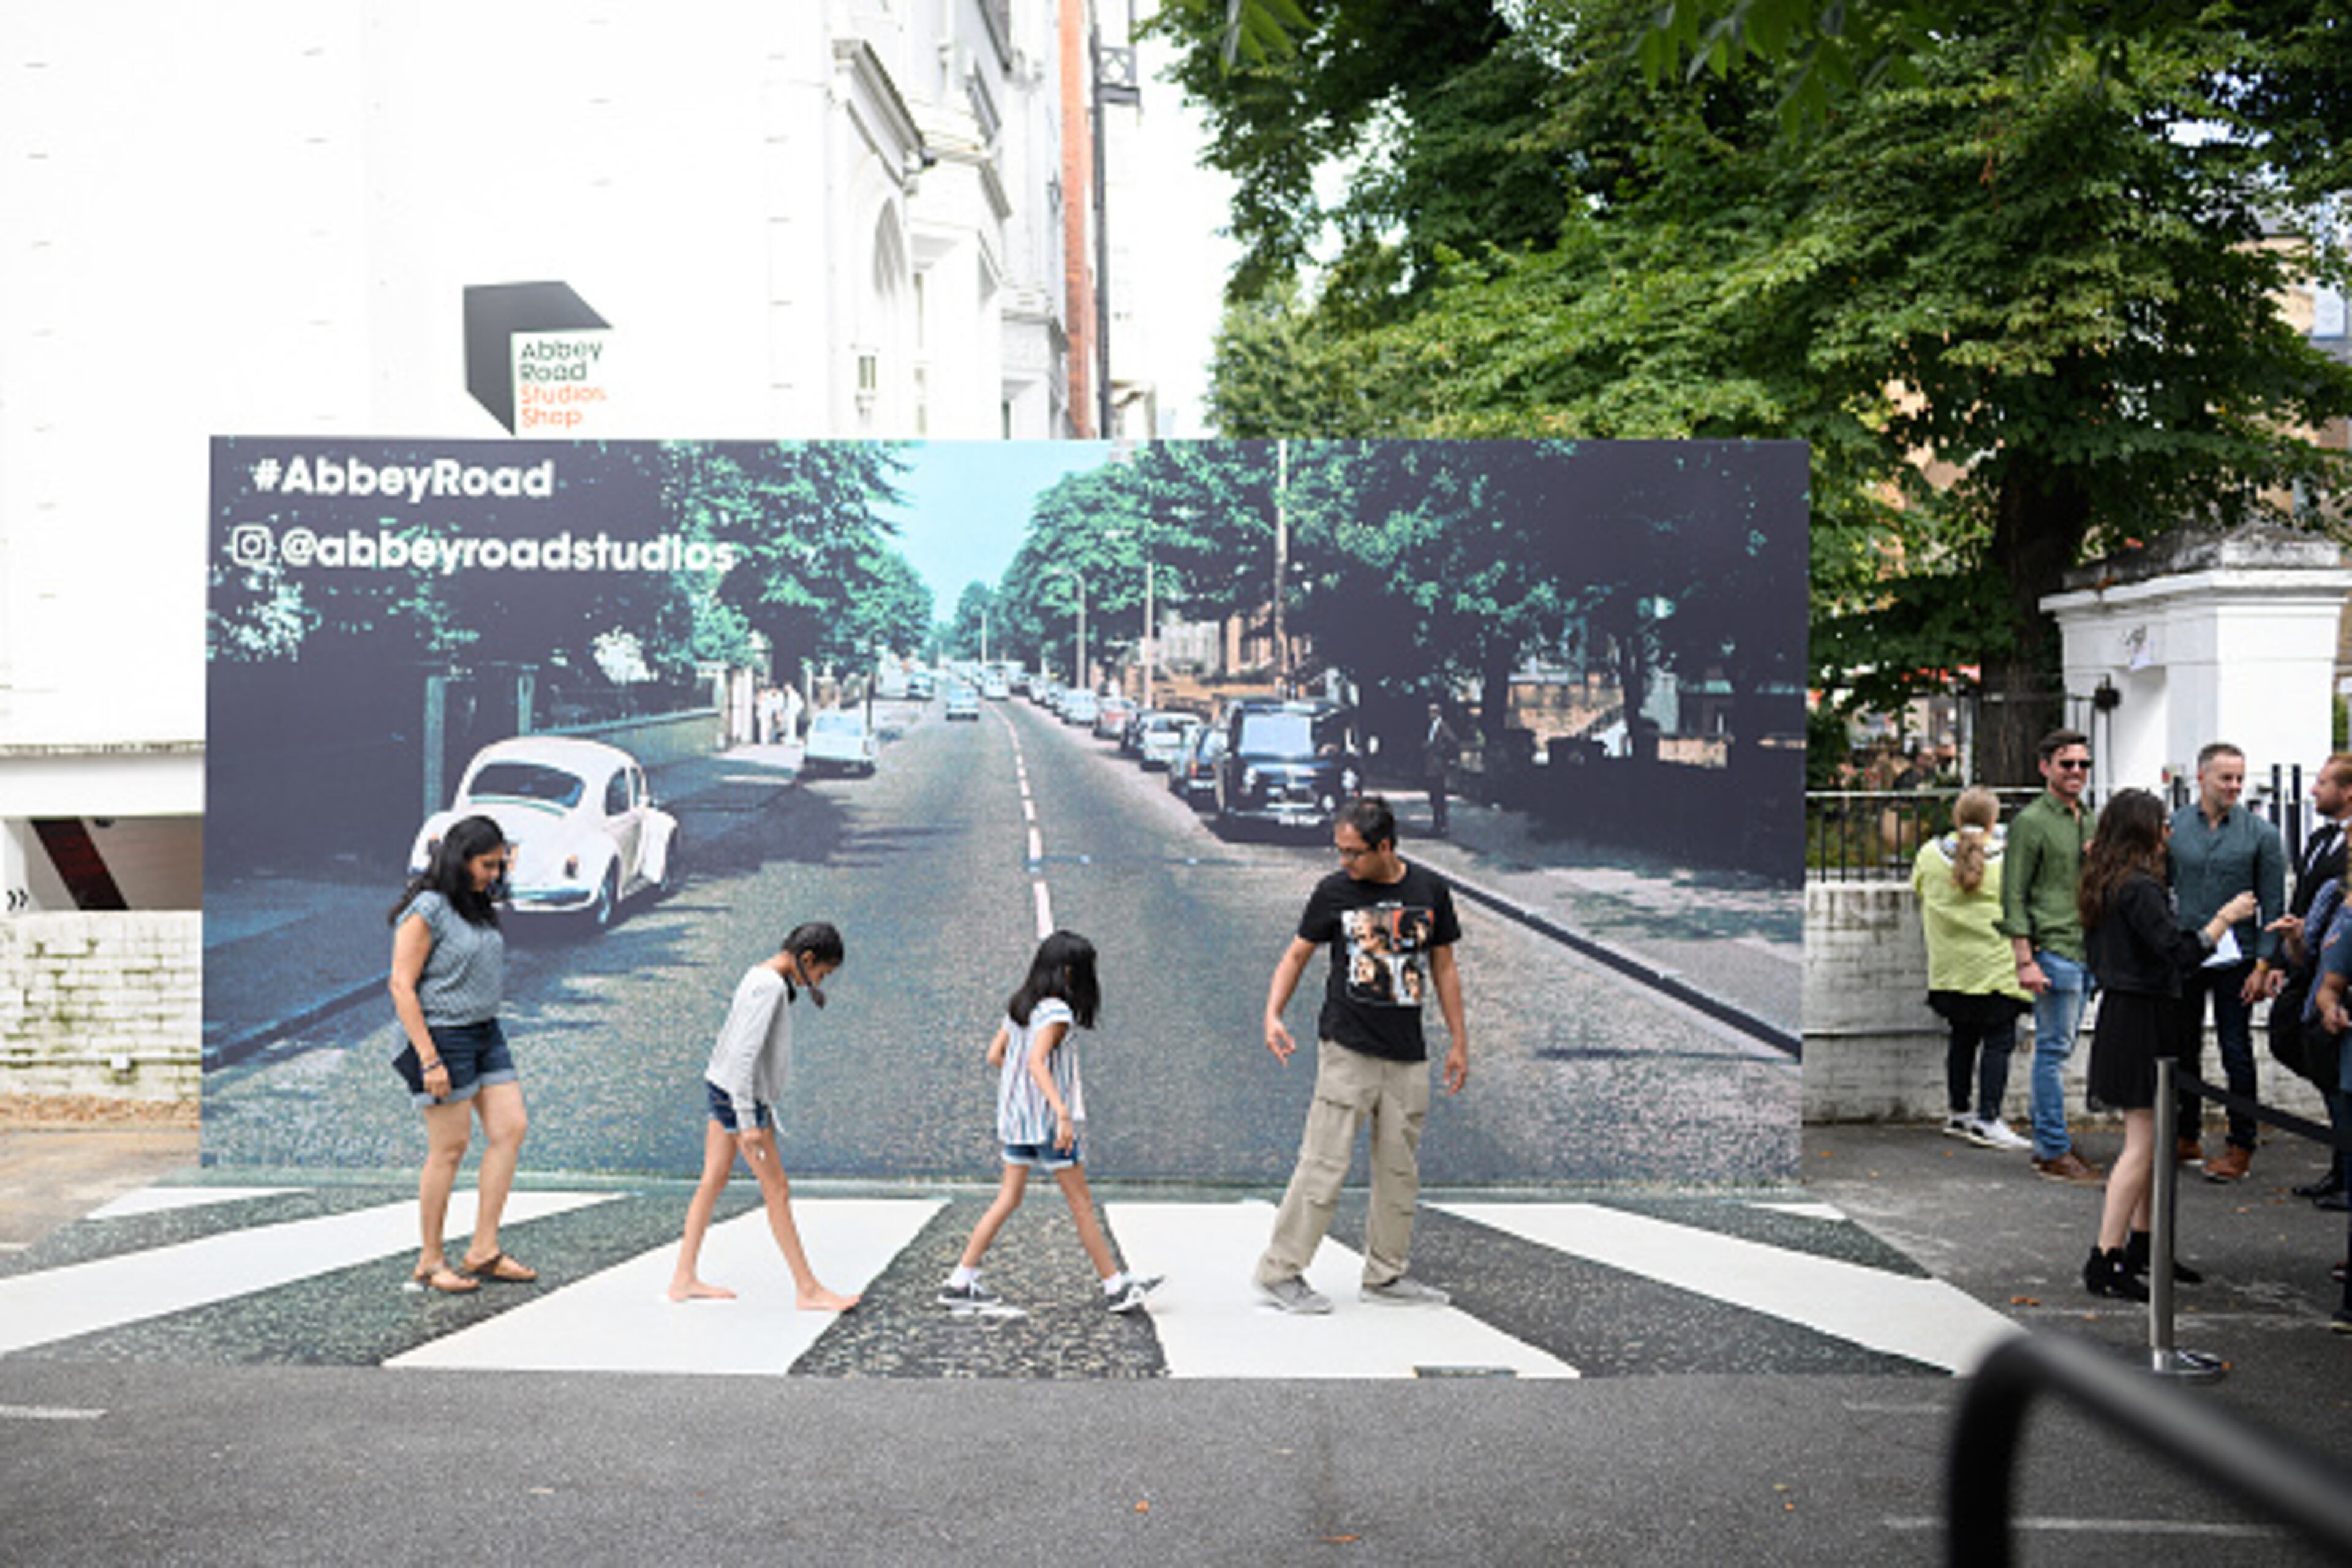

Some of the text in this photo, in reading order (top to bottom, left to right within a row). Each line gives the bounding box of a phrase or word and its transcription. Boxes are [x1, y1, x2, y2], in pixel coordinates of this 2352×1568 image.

[520, 339, 602, 361] Abbey
[519, 361, 587, 380] Road
[520, 383, 607, 404] Studios
[521, 407, 583, 429] Shop
[253, 459, 554, 503] #AbbeyRoad
[282, 529, 736, 575] @abbeyroadstudios
